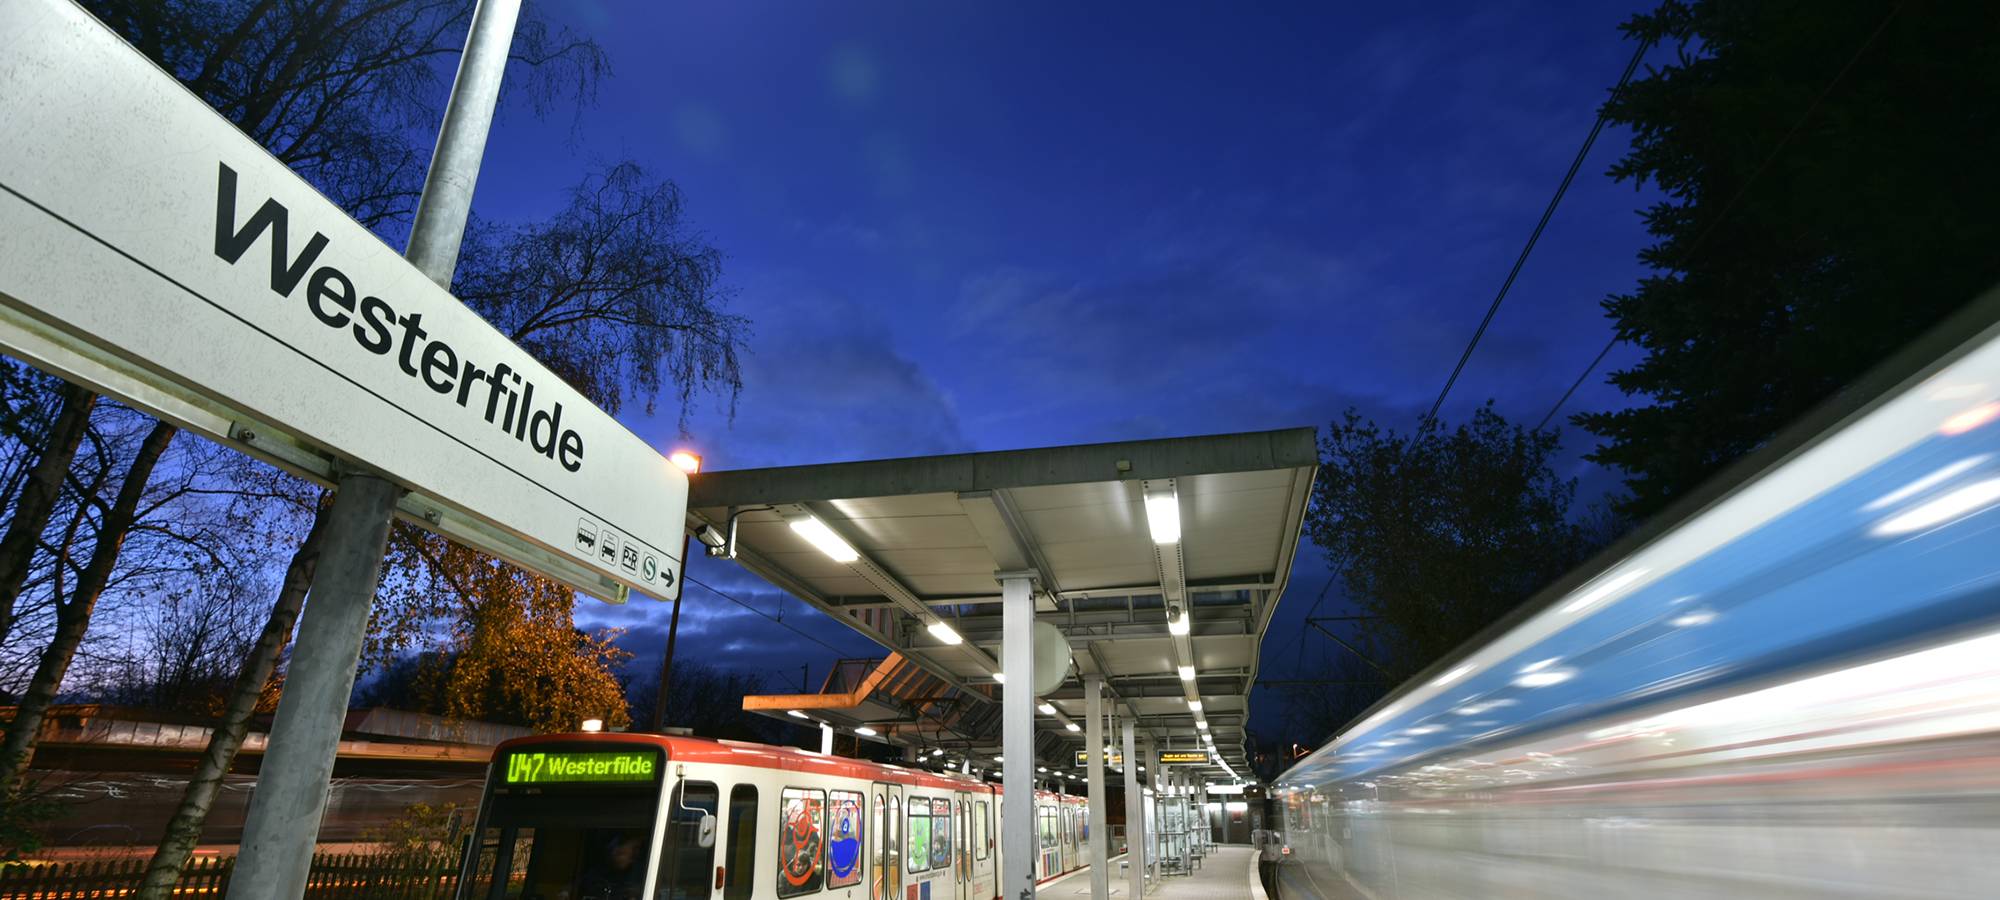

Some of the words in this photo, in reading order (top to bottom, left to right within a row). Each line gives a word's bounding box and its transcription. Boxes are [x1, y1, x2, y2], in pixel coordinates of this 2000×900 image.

[214, 161, 584, 473] Westerfilde
[644, 556, 656, 581] S
[507, 753, 545, 782] U47
[548, 756, 652, 775] Westerfilde
